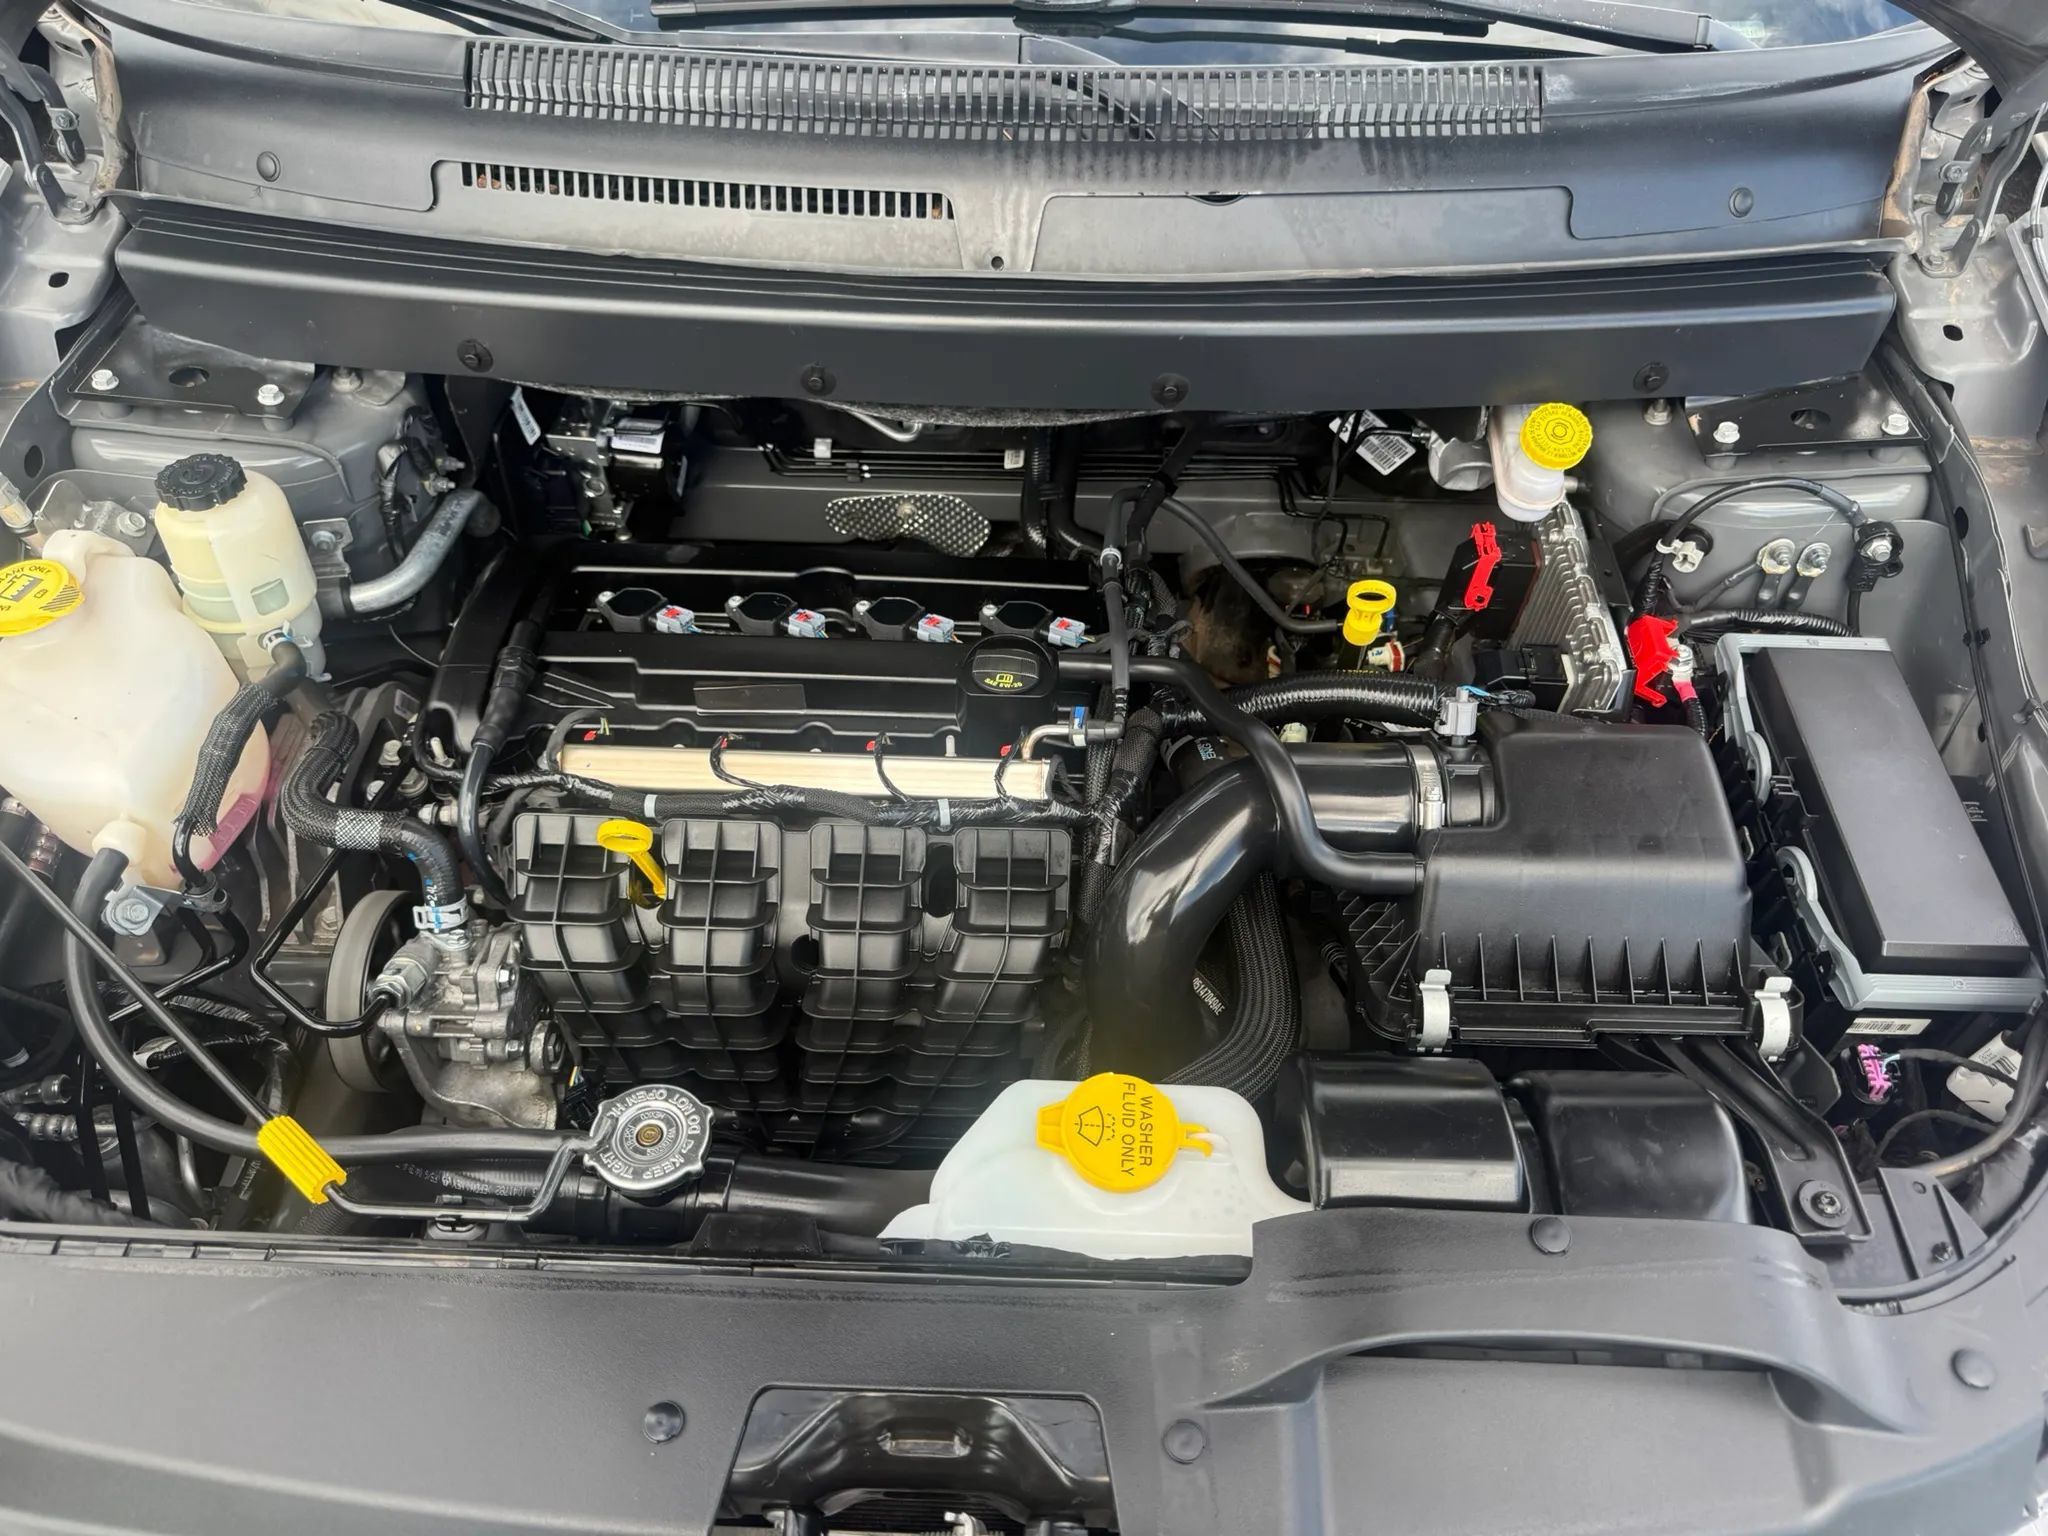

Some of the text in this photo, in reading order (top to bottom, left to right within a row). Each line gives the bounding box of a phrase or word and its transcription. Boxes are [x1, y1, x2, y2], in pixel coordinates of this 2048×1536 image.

[625, 1089, 668, 1108] OPEN
[668, 1093, 697, 1119] NOT
[687, 1114, 702, 1135] DO
[1120, 1082, 1136, 1177] FLUID ONLY
[1139, 1095, 1154, 1167] WASHER
[599, 1151, 686, 1179] KEEP TIGHT
